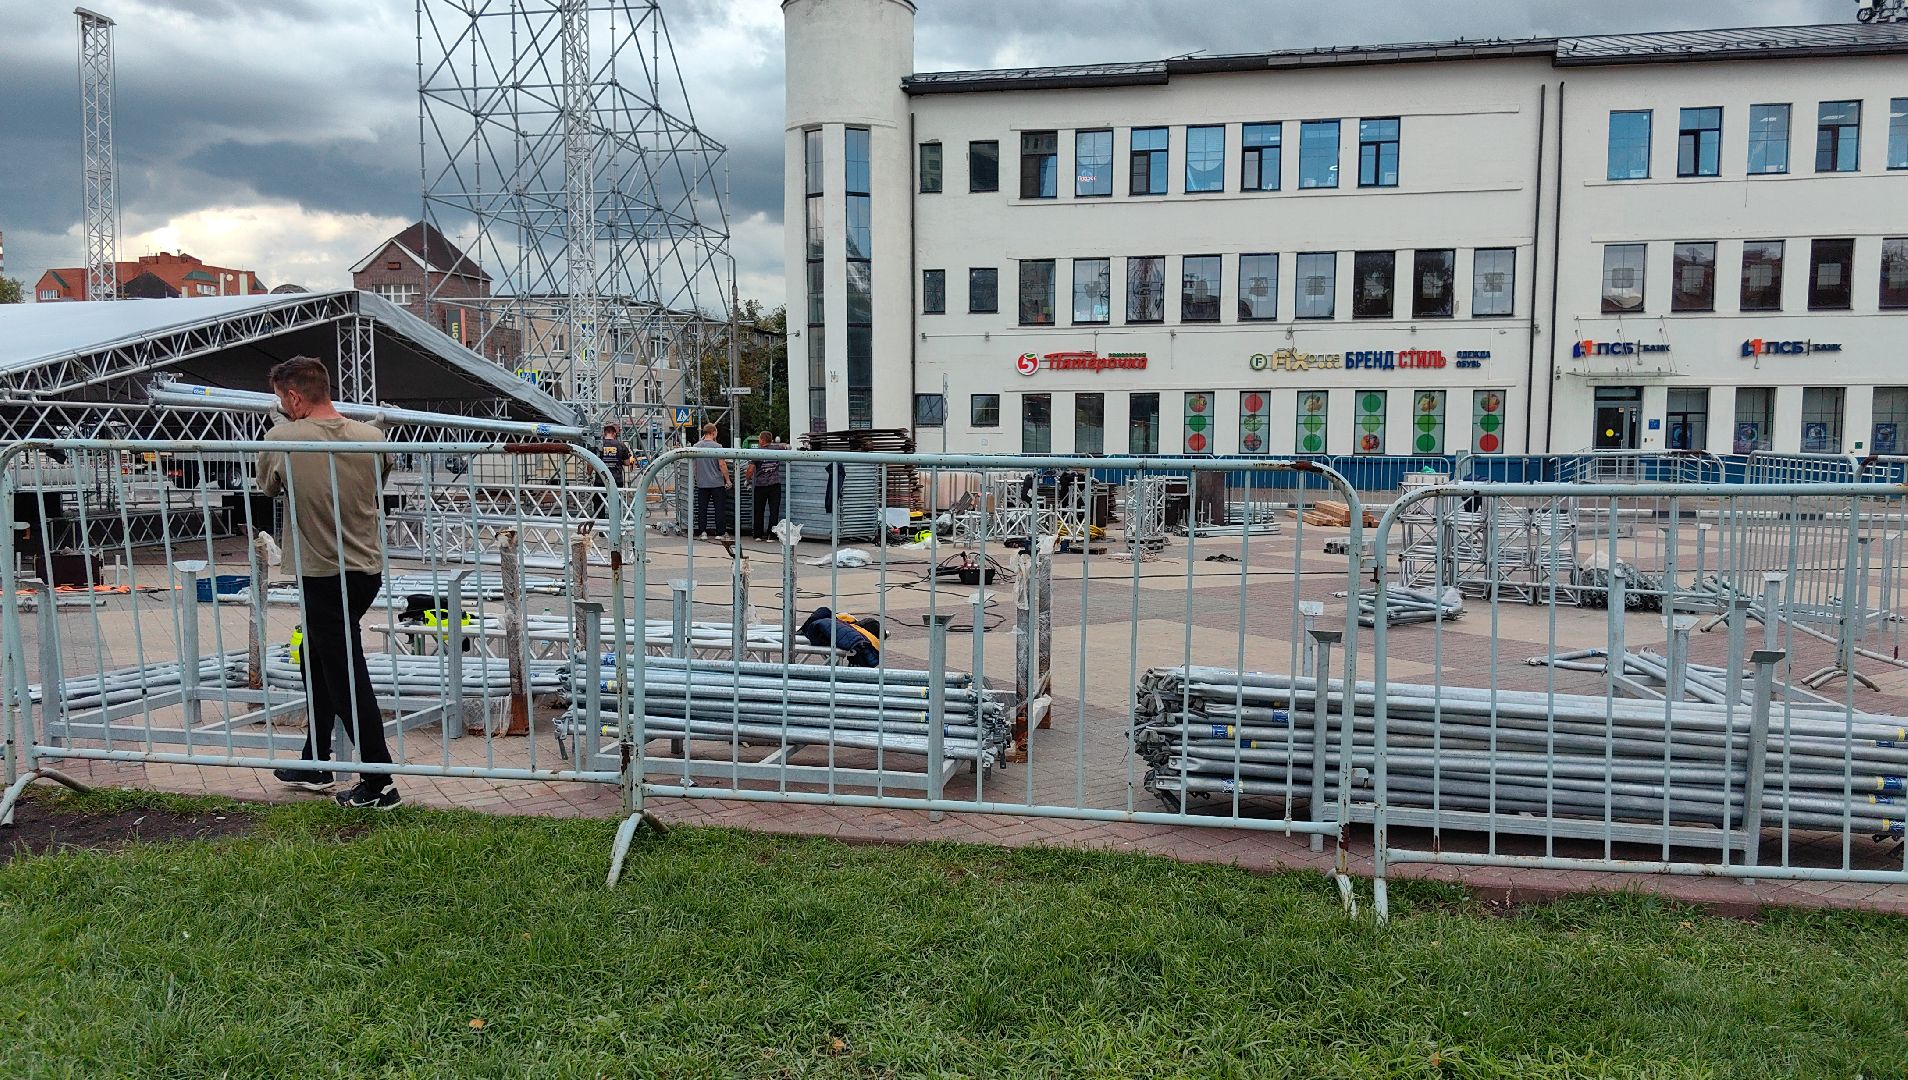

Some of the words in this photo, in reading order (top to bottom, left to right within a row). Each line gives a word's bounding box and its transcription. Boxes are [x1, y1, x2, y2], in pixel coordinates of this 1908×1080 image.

[1597, 342, 1634, 355] ПСБ
[1643, 344, 1671, 352] БАНК
[1766, 341, 1804, 354] ПСБ
[1814, 344, 1843, 352] БАНК
[1345, 351, 1395, 370] БРЕНД
[1399, 350, 1447, 369] СТИЛЬ
[1456, 350, 1490, 359] ОДЕЖДА
[1456, 360, 1482, 368] ОБУВЬ
